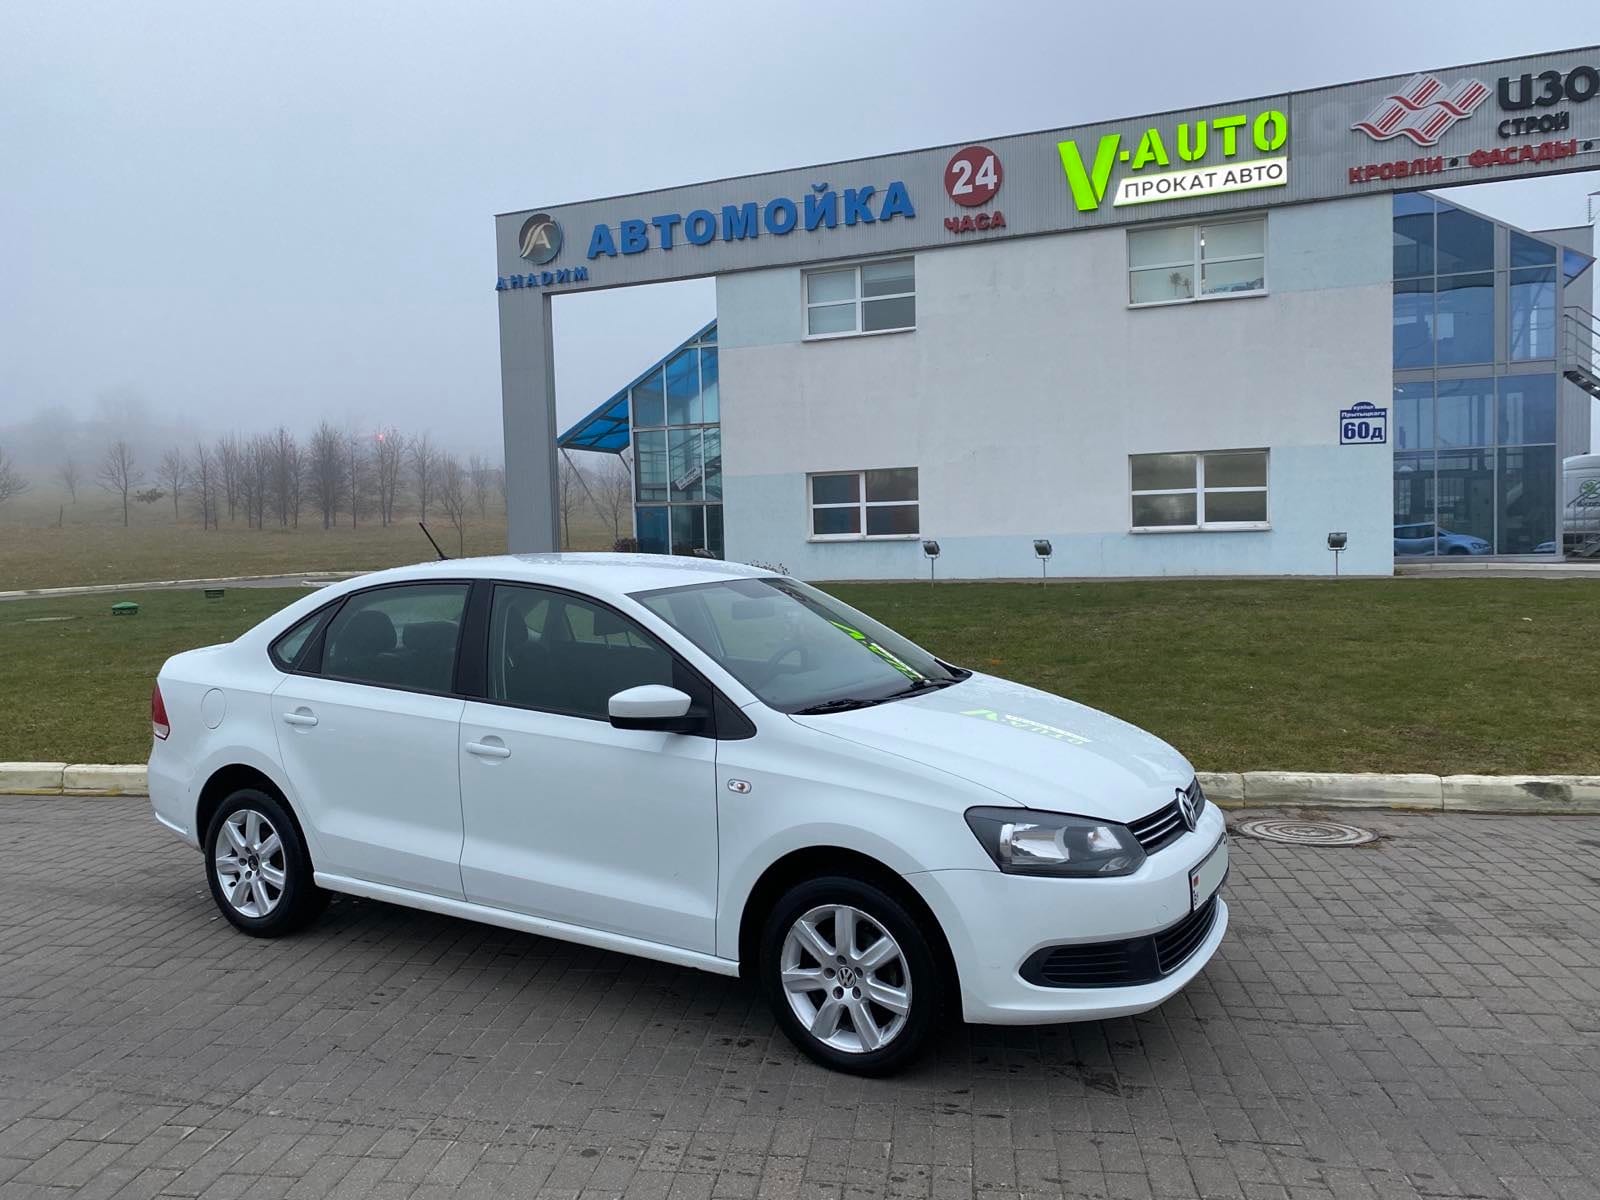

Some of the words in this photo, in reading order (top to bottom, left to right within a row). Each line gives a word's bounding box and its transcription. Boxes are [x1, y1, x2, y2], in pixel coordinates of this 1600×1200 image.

[1498, 111, 1569, 139] СТРОЙ
[1468, 139, 1577, 168] ФАСАДЫ
[951, 155, 998, 196] 24
[1125, 172, 1218, 198] ПРОКАТ
[1223, 163, 1283, 186] АВТО
[1349, 156, 1442, 184] КРОВЛИ
[586, 181, 916, 260] АВТОМОЙКА
[943, 211, 1006, 233] ЧАСА
